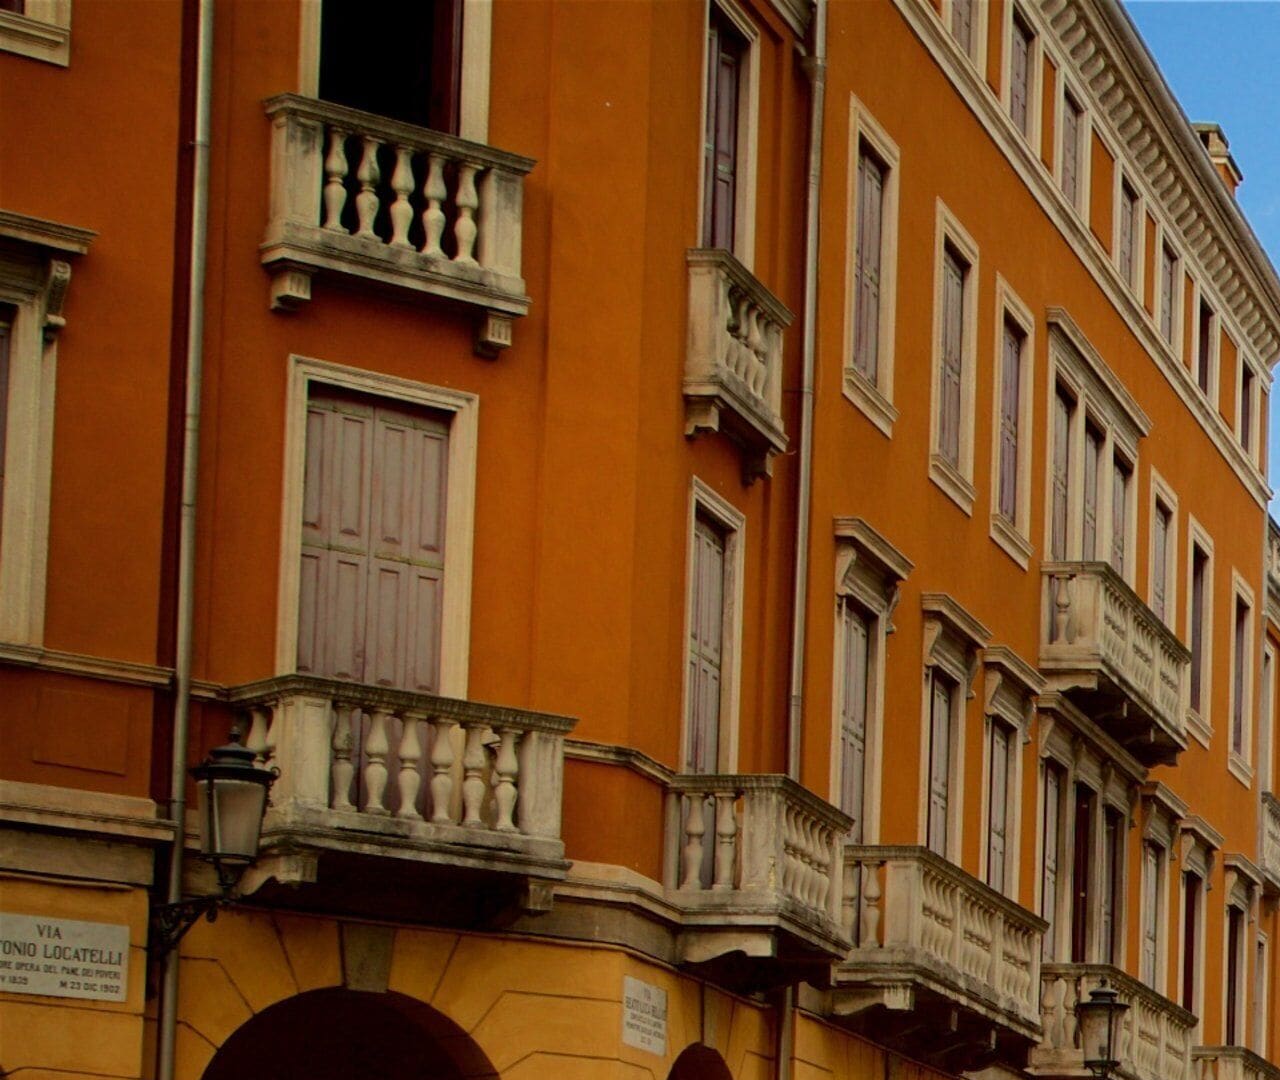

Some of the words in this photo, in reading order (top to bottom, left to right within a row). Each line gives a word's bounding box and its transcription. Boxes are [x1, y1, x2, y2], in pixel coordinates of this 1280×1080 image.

[36, 924, 62, 940] VIA
[0, 940, 37, 958] ONIO
[43, 944, 122, 966] LOCATELLI
[15, 961, 41, 972] OPERA
[61, 966, 79, 976] PANE
[95, 969, 121, 980] POVERI
